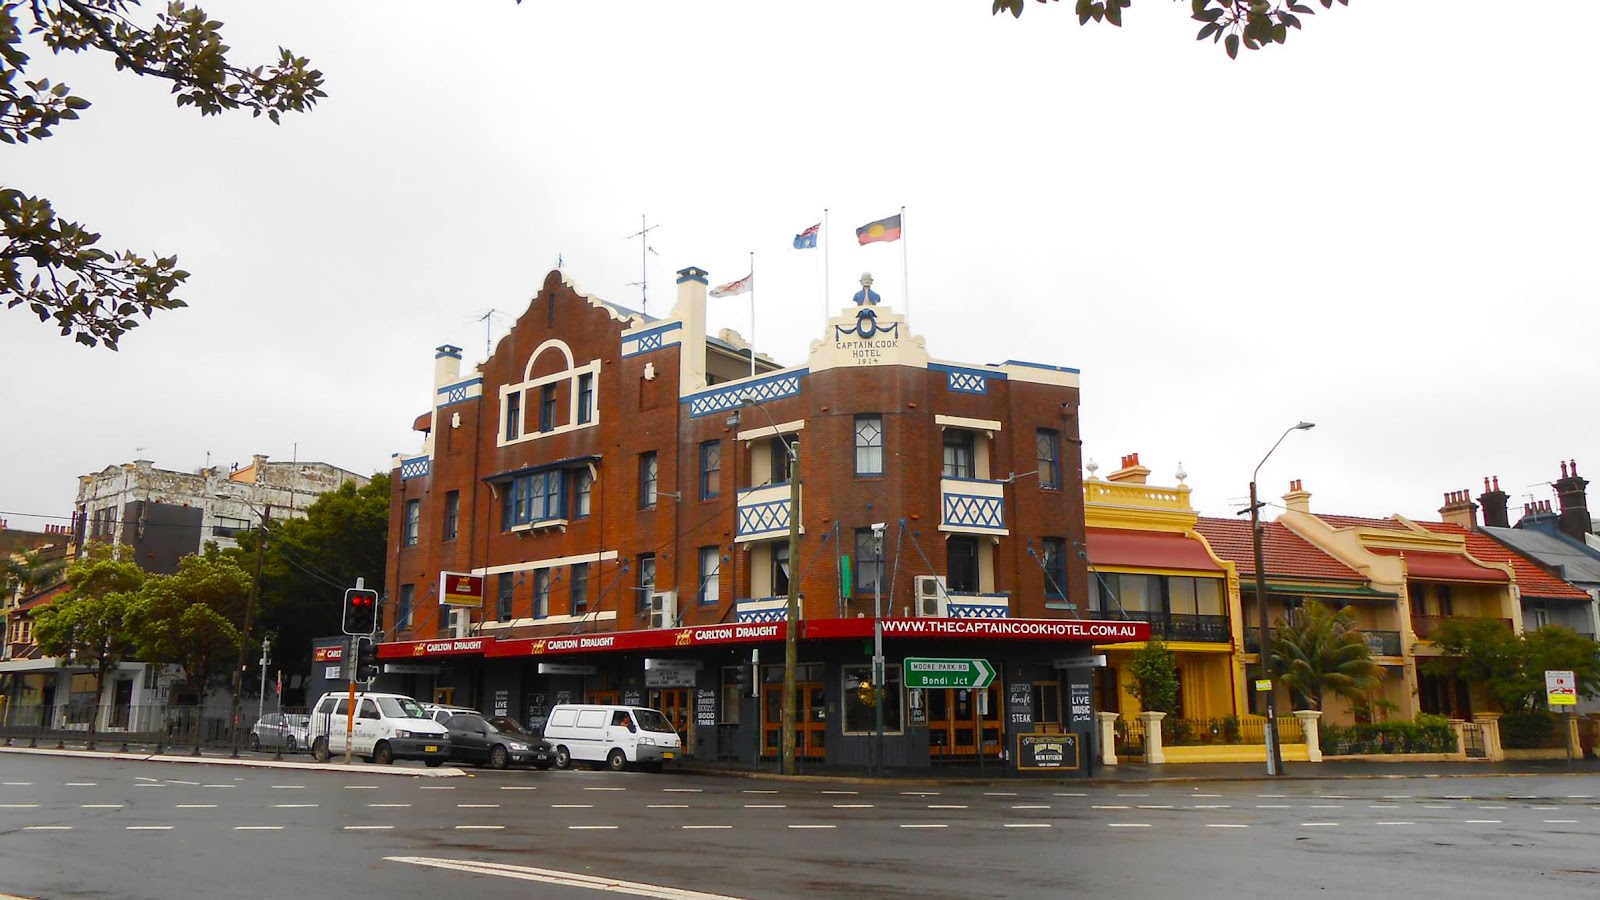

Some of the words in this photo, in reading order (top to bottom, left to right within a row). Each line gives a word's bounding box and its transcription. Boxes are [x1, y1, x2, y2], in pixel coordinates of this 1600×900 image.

[852, 349, 881, 357] HOTEL
[880, 620, 1136, 636] WWW.THECAPTAINCOOKHOTEL.COM.AU
[694, 629, 733, 640] CARLTON
[736, 626, 778, 637] DRAUGHT
[427, 643, 452, 652] CARLTON
[454, 641, 482, 650] DRAUGHT
[548, 640, 578, 650] CARLTON
[581, 637, 614, 647] DRAUGHT
[922, 676, 948, 685] Bondi
[953, 676, 968, 685] Jct
[1071, 696, 1090, 704] LIVE
[1072, 705, 1091, 714] MUSIC
[1012, 714, 1031, 723] STEAK
